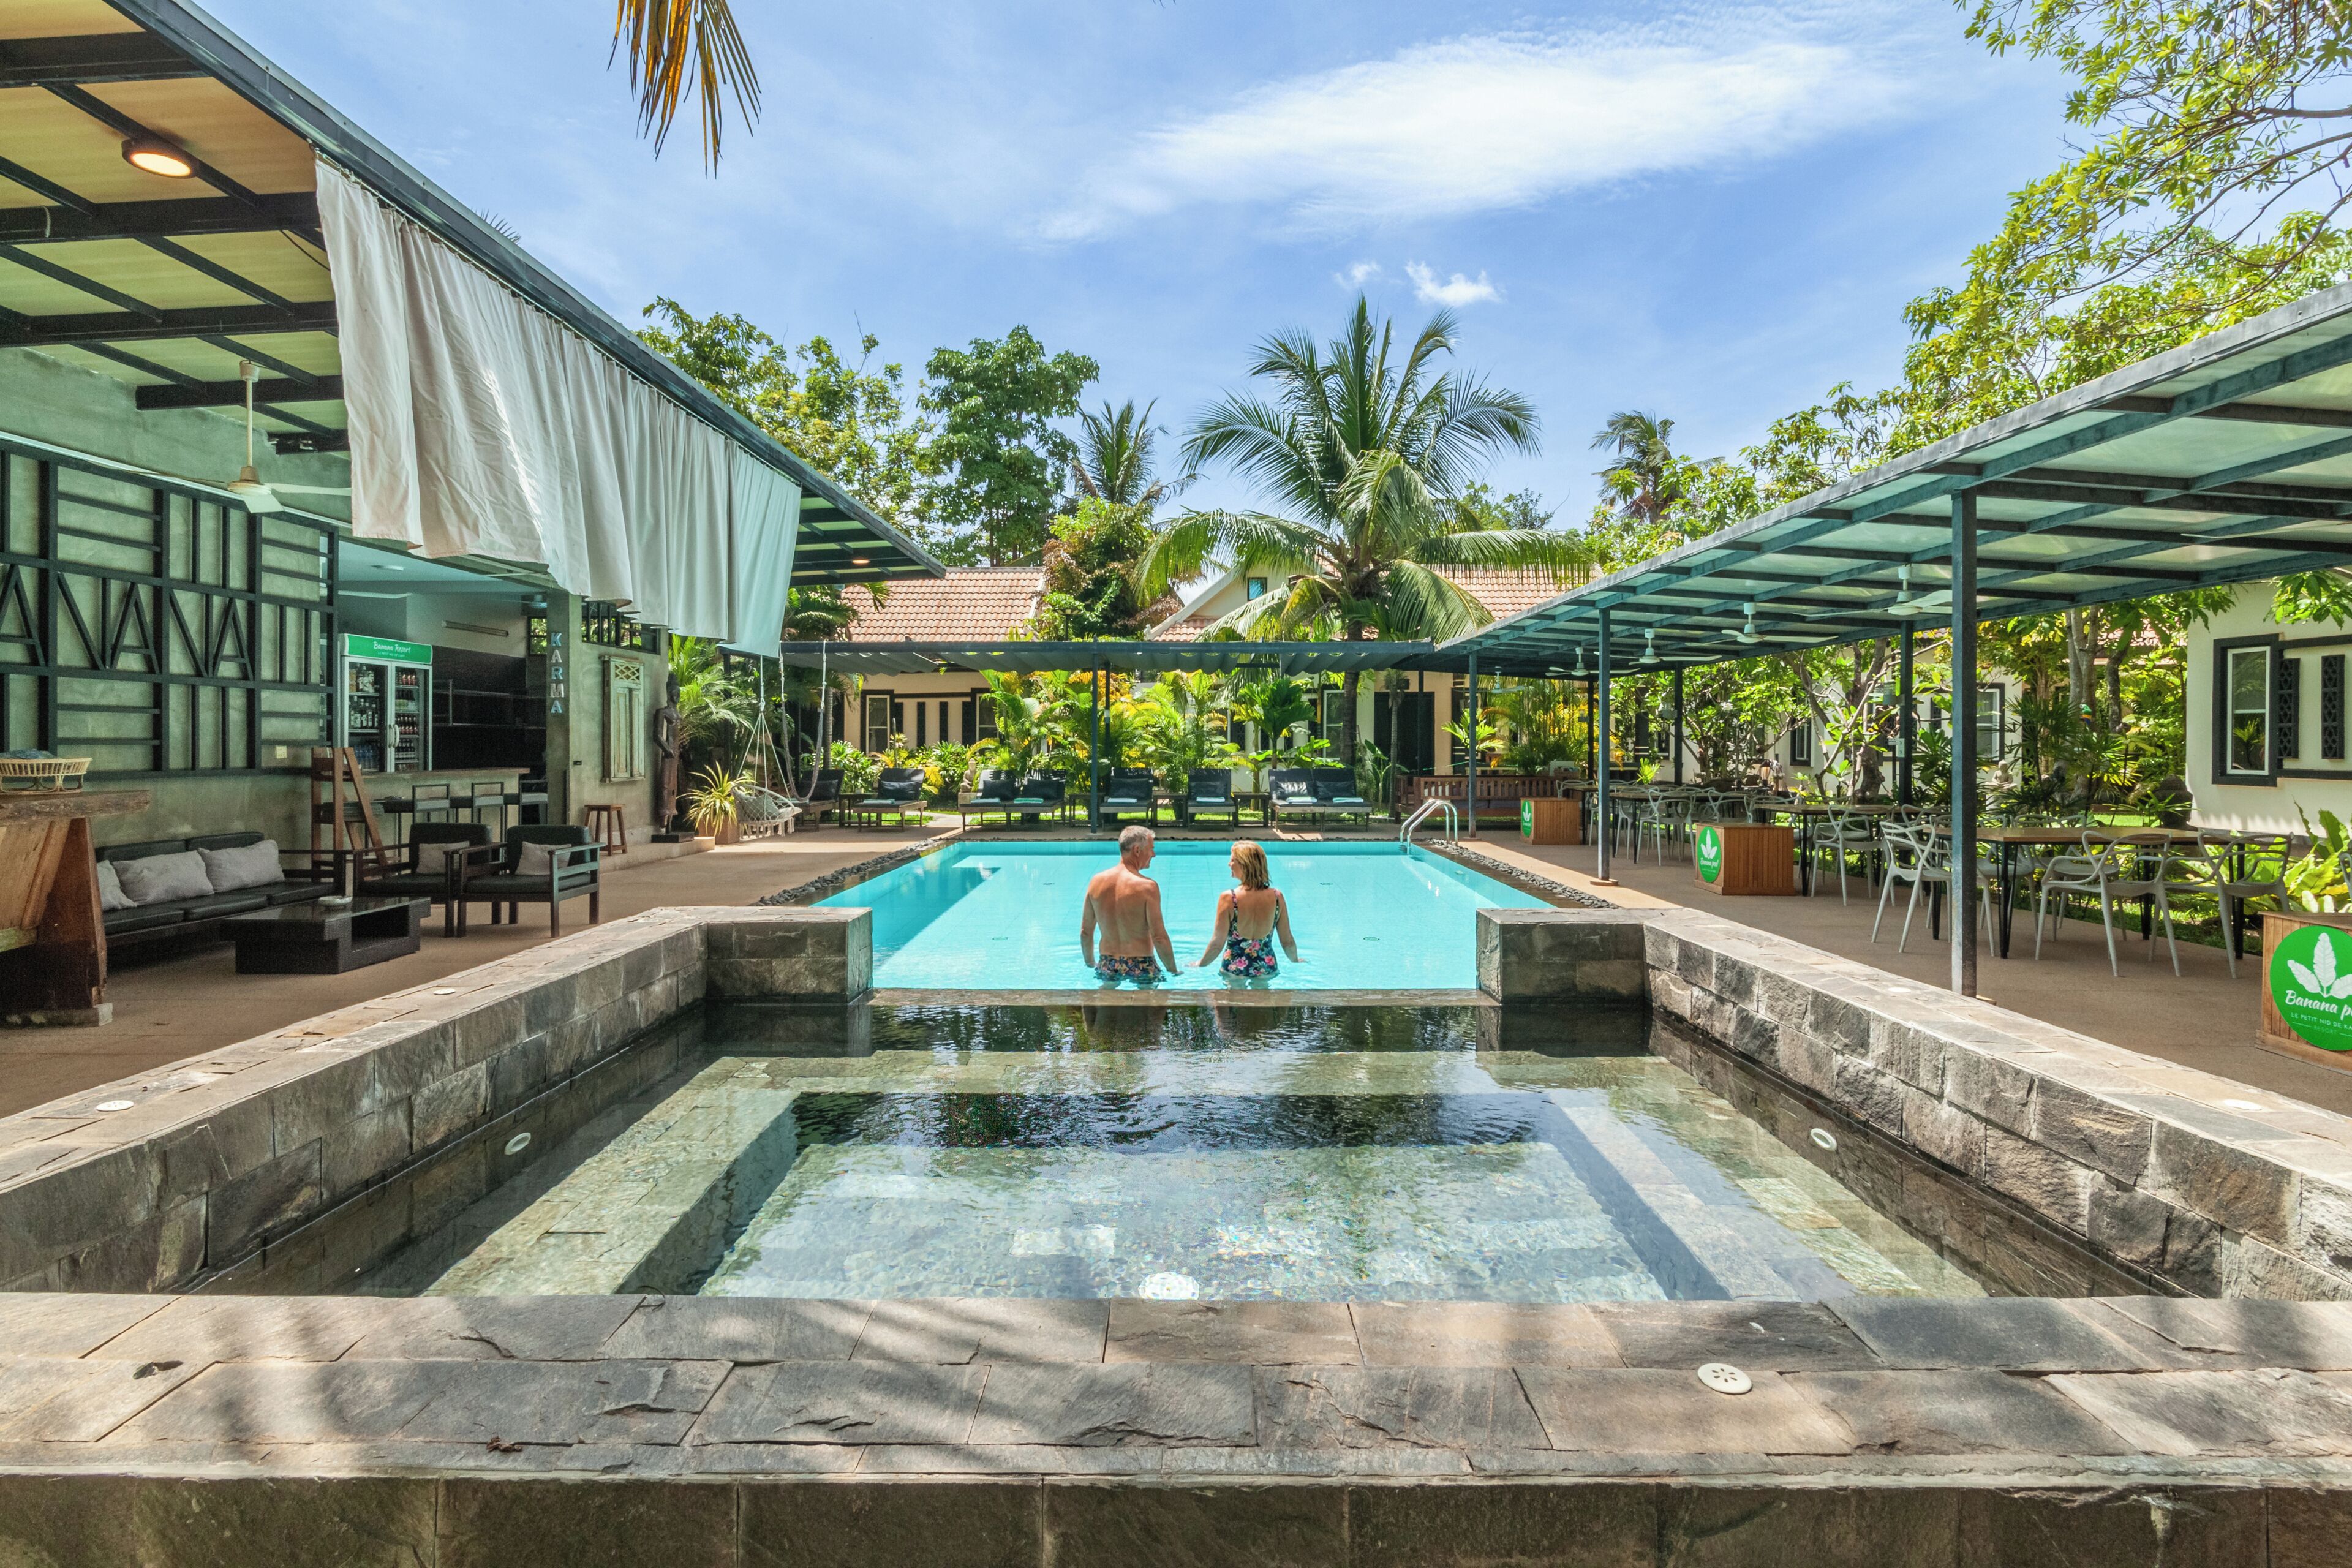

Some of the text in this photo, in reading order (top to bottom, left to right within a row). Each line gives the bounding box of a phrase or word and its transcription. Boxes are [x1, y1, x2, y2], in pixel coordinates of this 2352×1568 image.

[373, 641, 393, 651] Banana
[550, 632, 565, 714] KARMA
[2285, 990, 2352, 1021] Banana p
